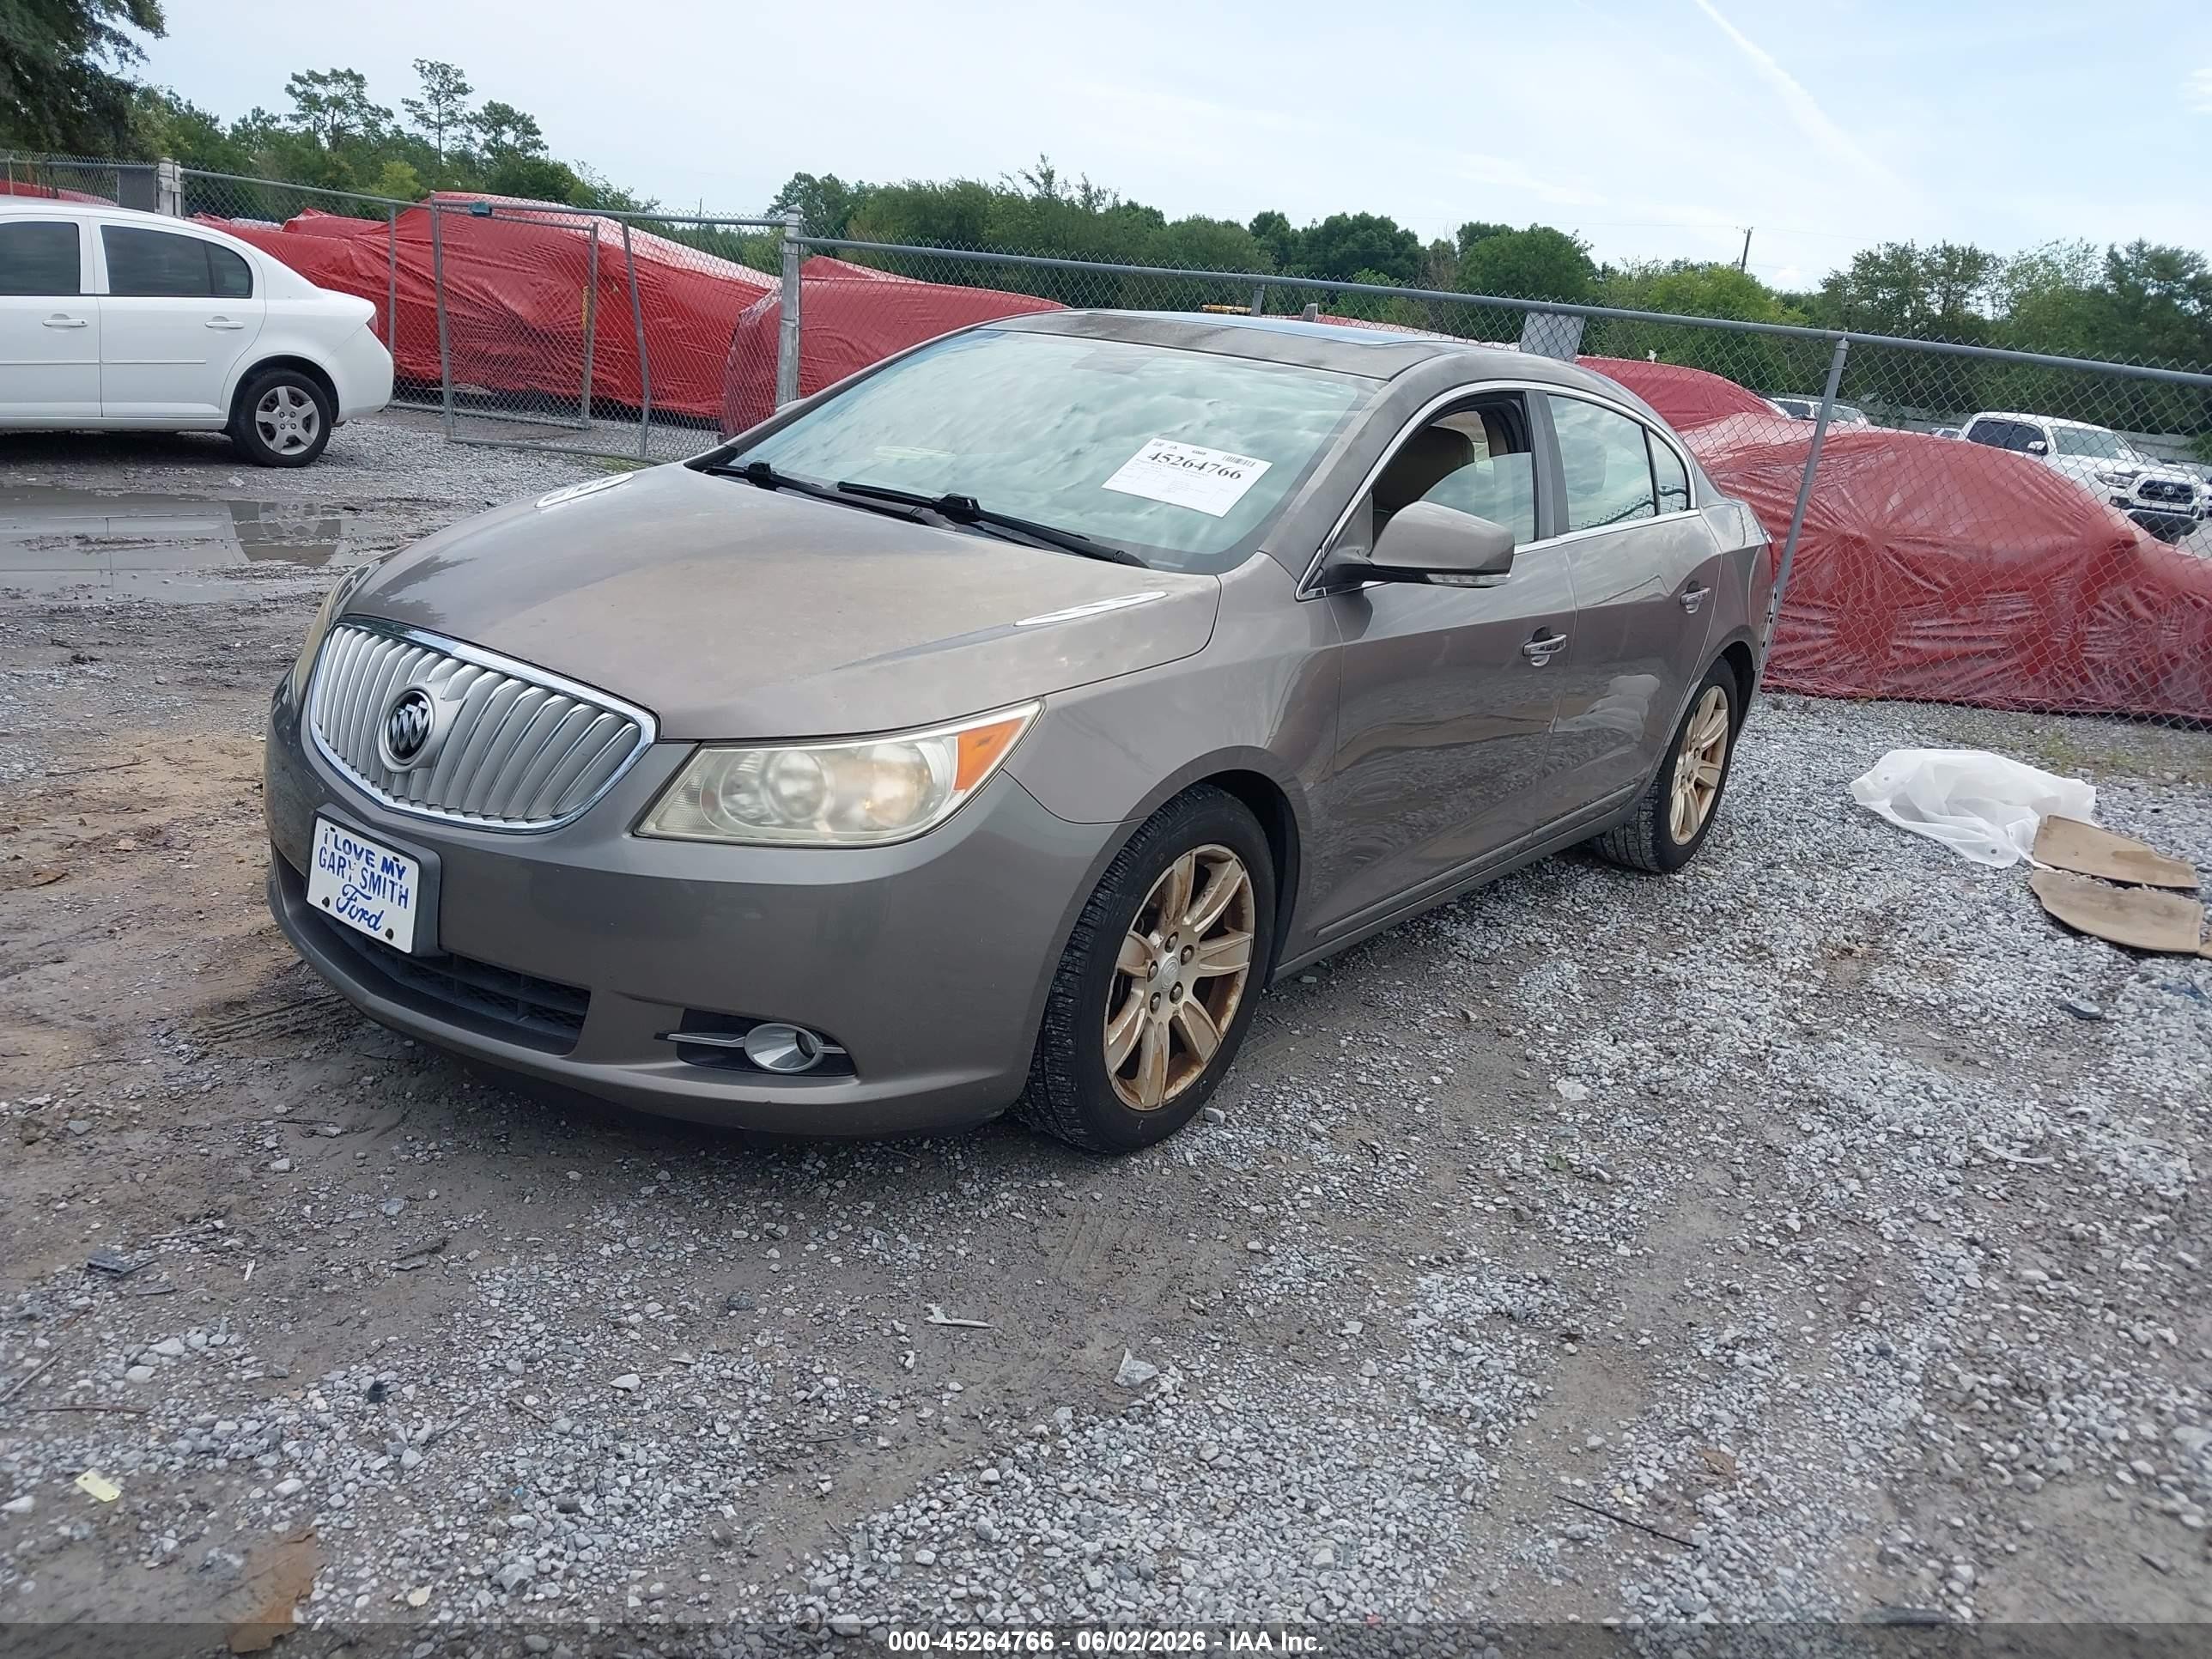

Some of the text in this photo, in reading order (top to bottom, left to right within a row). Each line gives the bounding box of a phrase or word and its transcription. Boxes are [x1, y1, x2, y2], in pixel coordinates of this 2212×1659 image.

[1147, 451, 1244, 480] 45264766
[334, 833, 376, 869] LOVE
[380, 855, 407, 881] MY
[336, 884, 385, 932] Ford
[359, 866, 410, 909] SMITH
